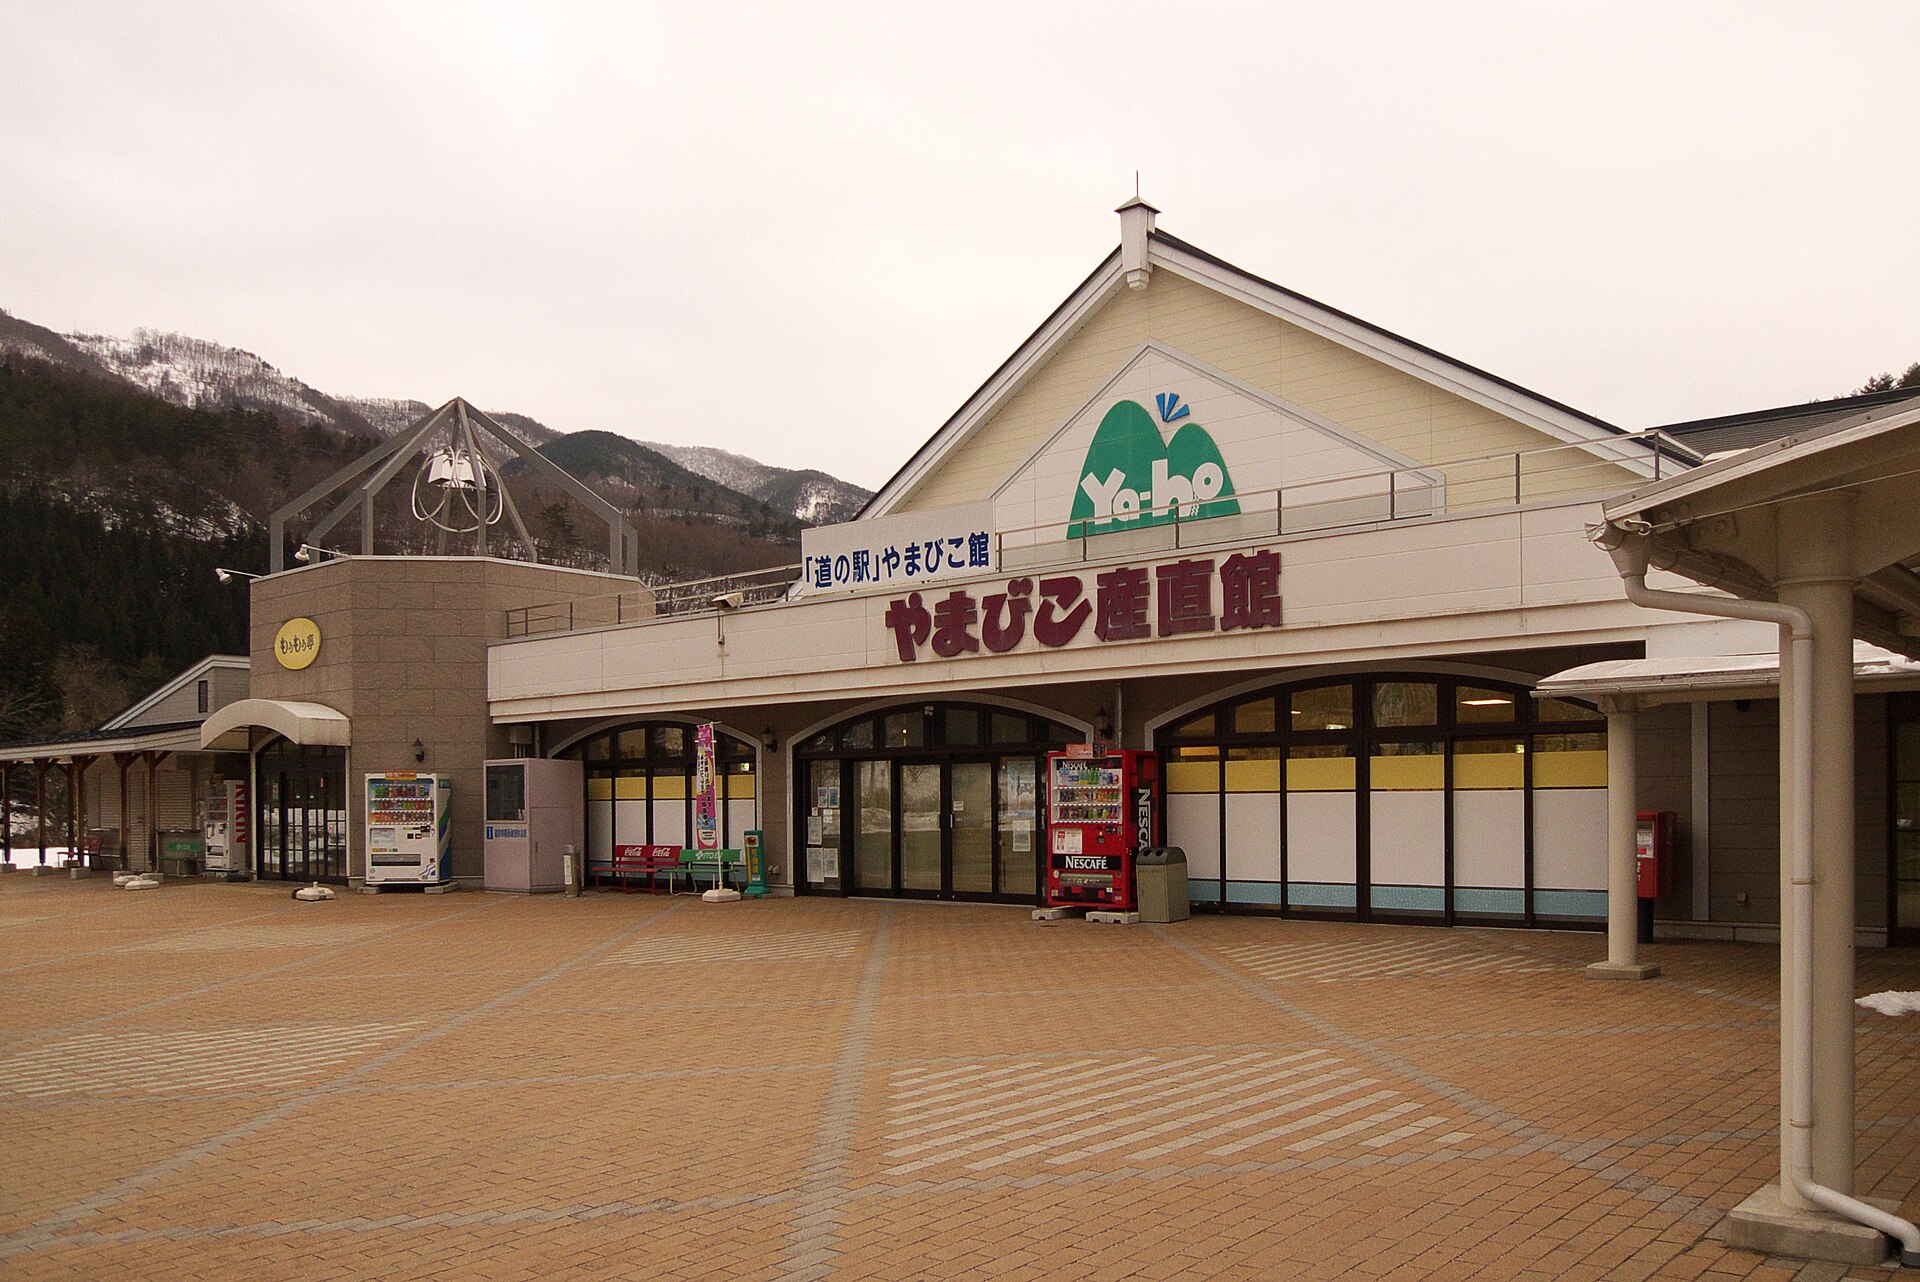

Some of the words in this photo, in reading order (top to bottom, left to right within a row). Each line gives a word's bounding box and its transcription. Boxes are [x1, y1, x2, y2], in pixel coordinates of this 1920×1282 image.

[805, 531, 989, 589] 「道の駅」やまびこ館
[885, 549, 1283, 662] やまびこ産直館
[1065, 855, 1107, 869] NESCAFÉ
